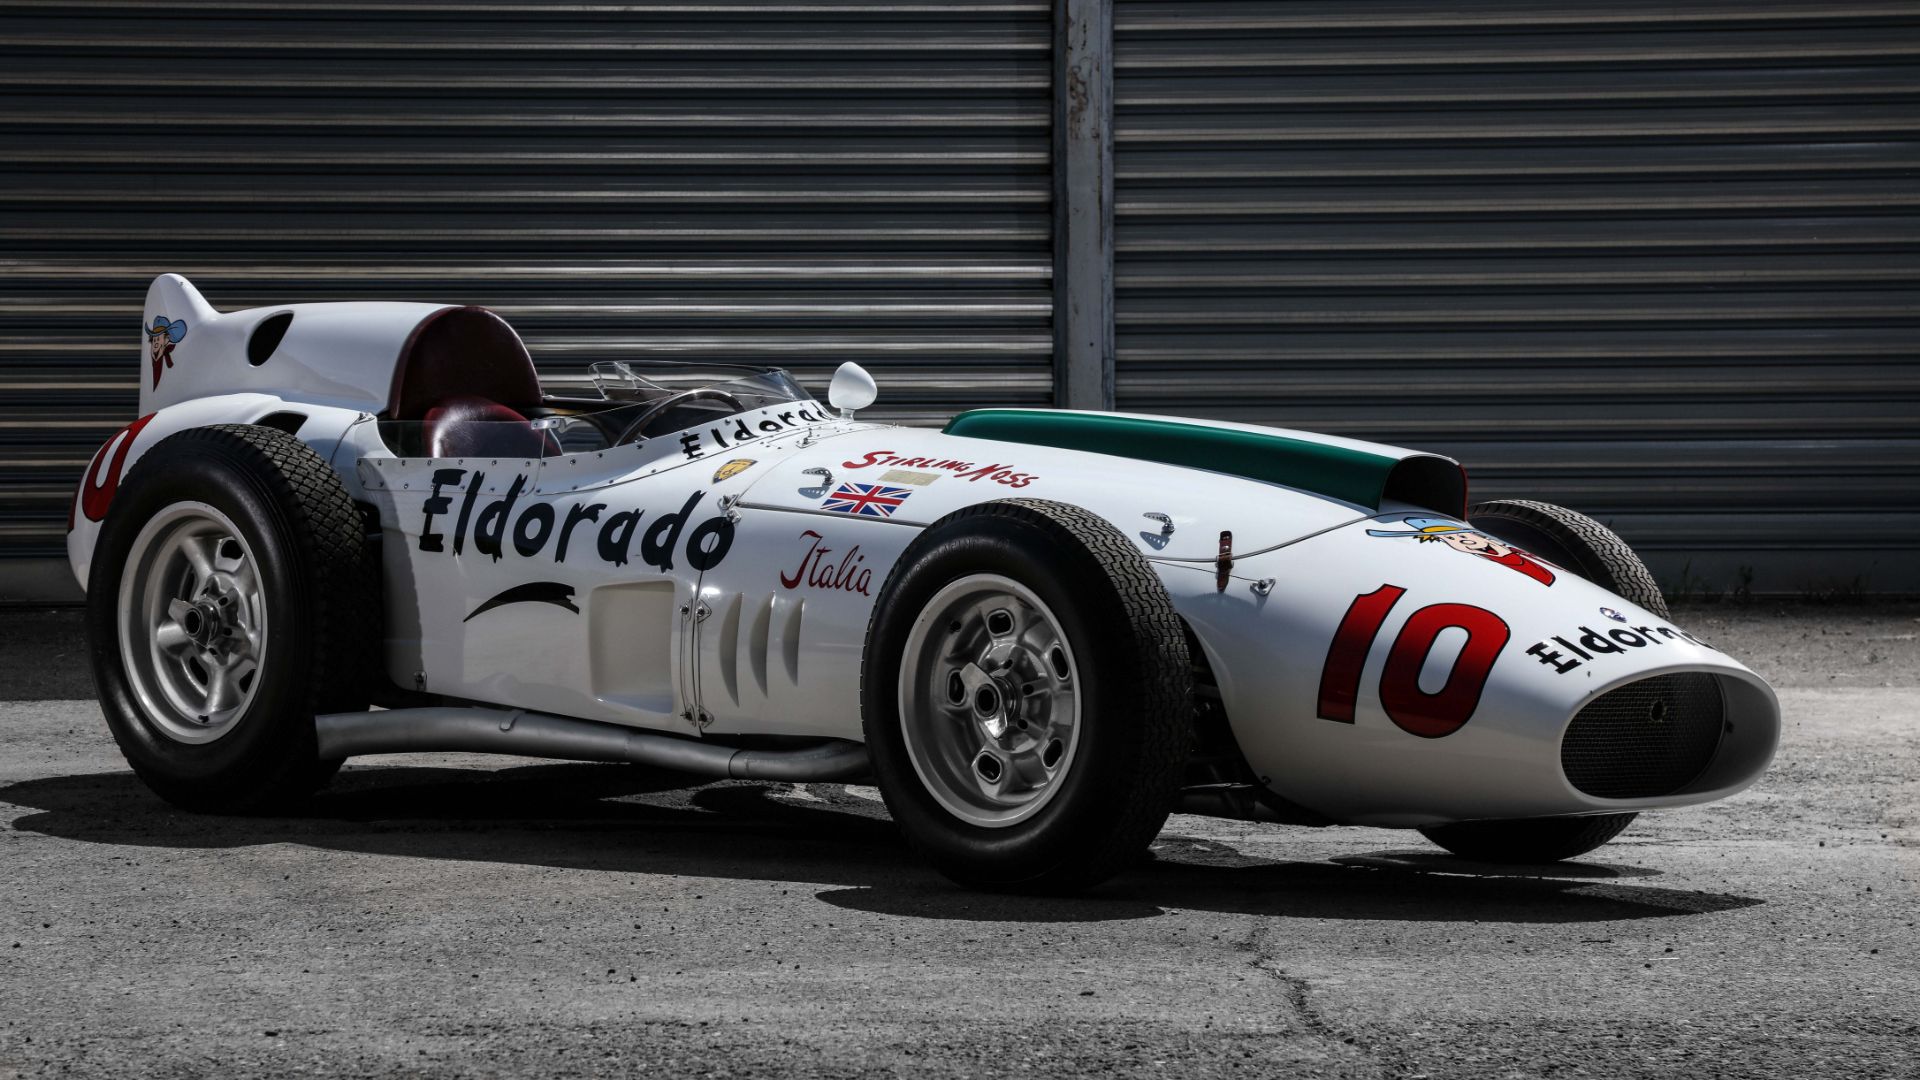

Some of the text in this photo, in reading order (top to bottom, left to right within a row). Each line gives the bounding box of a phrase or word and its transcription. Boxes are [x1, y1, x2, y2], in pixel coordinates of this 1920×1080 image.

[419, 468, 736, 573] Eldorado
[780, 530, 872, 597] Italia
[1316, 583, 1511, 739] 10
